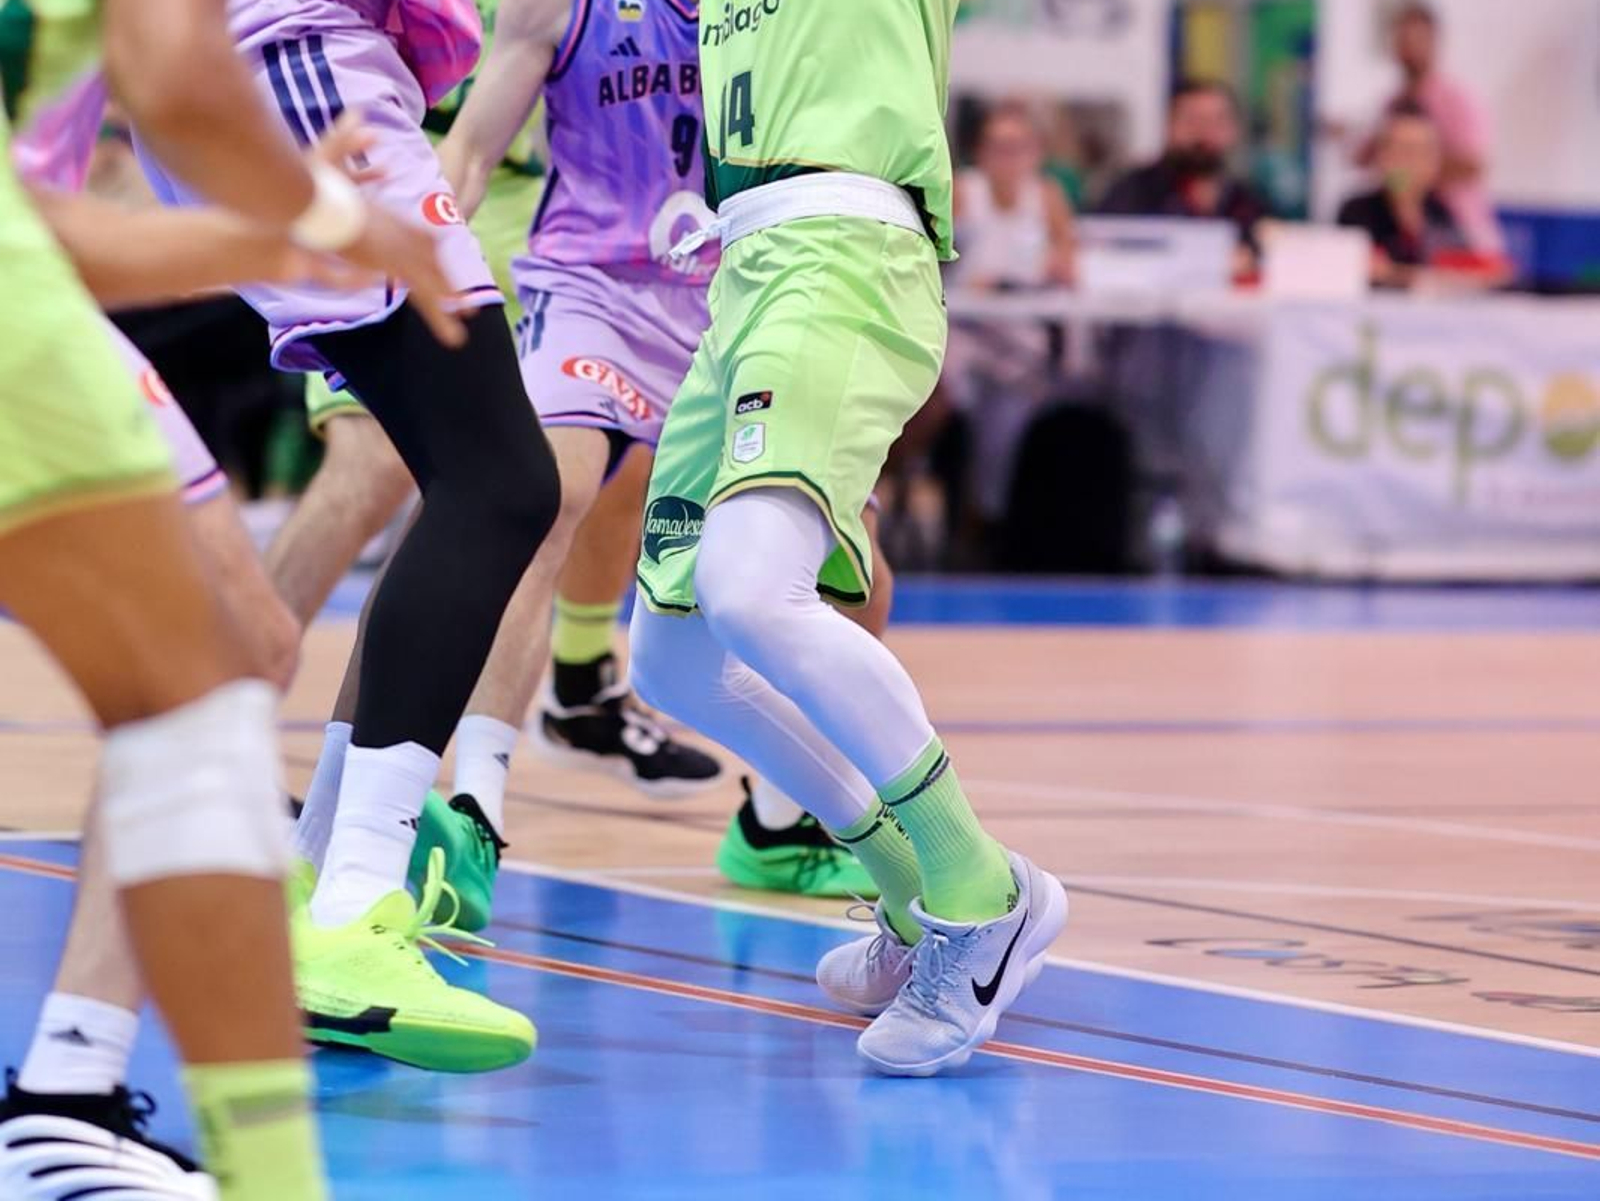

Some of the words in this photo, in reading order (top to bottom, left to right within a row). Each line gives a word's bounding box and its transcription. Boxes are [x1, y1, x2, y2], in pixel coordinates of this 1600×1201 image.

[598, 64, 671, 108] ALBA
[671, 113, 699, 179] 9
[738, 399, 763, 412] acb
